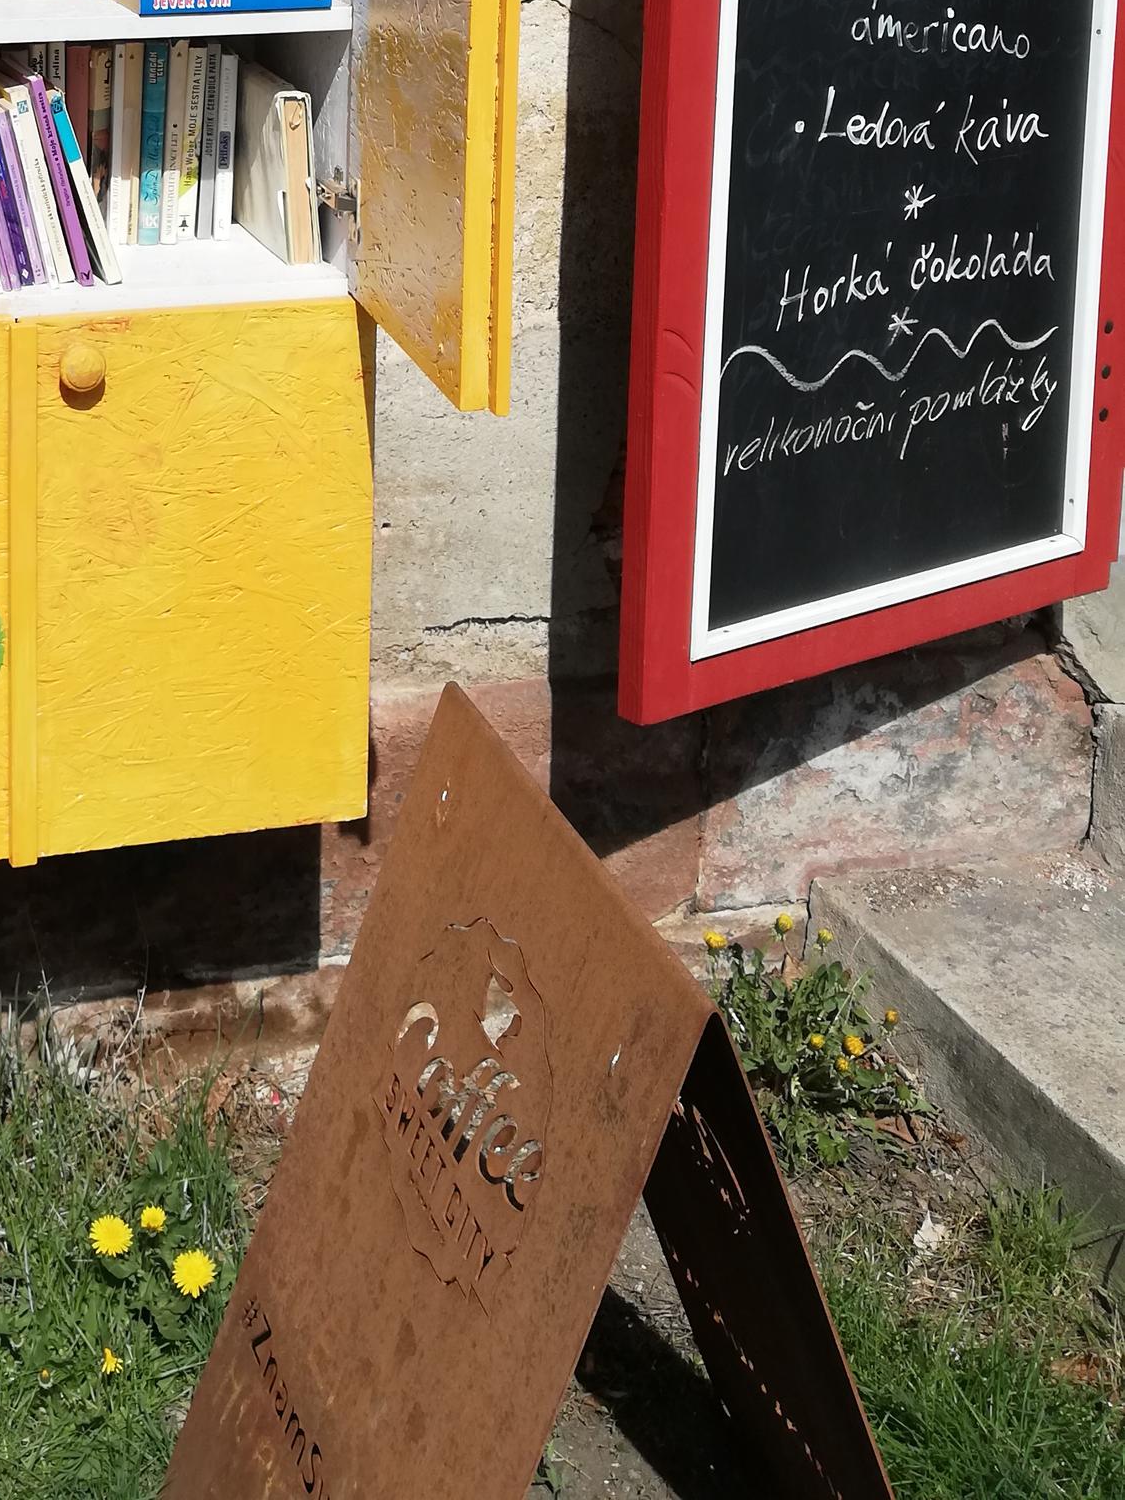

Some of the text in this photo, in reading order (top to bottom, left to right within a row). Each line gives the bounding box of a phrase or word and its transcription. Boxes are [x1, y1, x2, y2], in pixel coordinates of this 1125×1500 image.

[851, 7, 1031, 60] americano
[48, 137, 58, 157] Moje
[182, 53, 204, 188] Hans Weber MOJE SESTRA TILLY
[202, 136, 215, 157] JOSEF
[818, 85, 946, 151] Ledová
[776, 230, 1056, 332] Horká čokoláda
[386, 1073, 495, 1281] SWEET CITY
